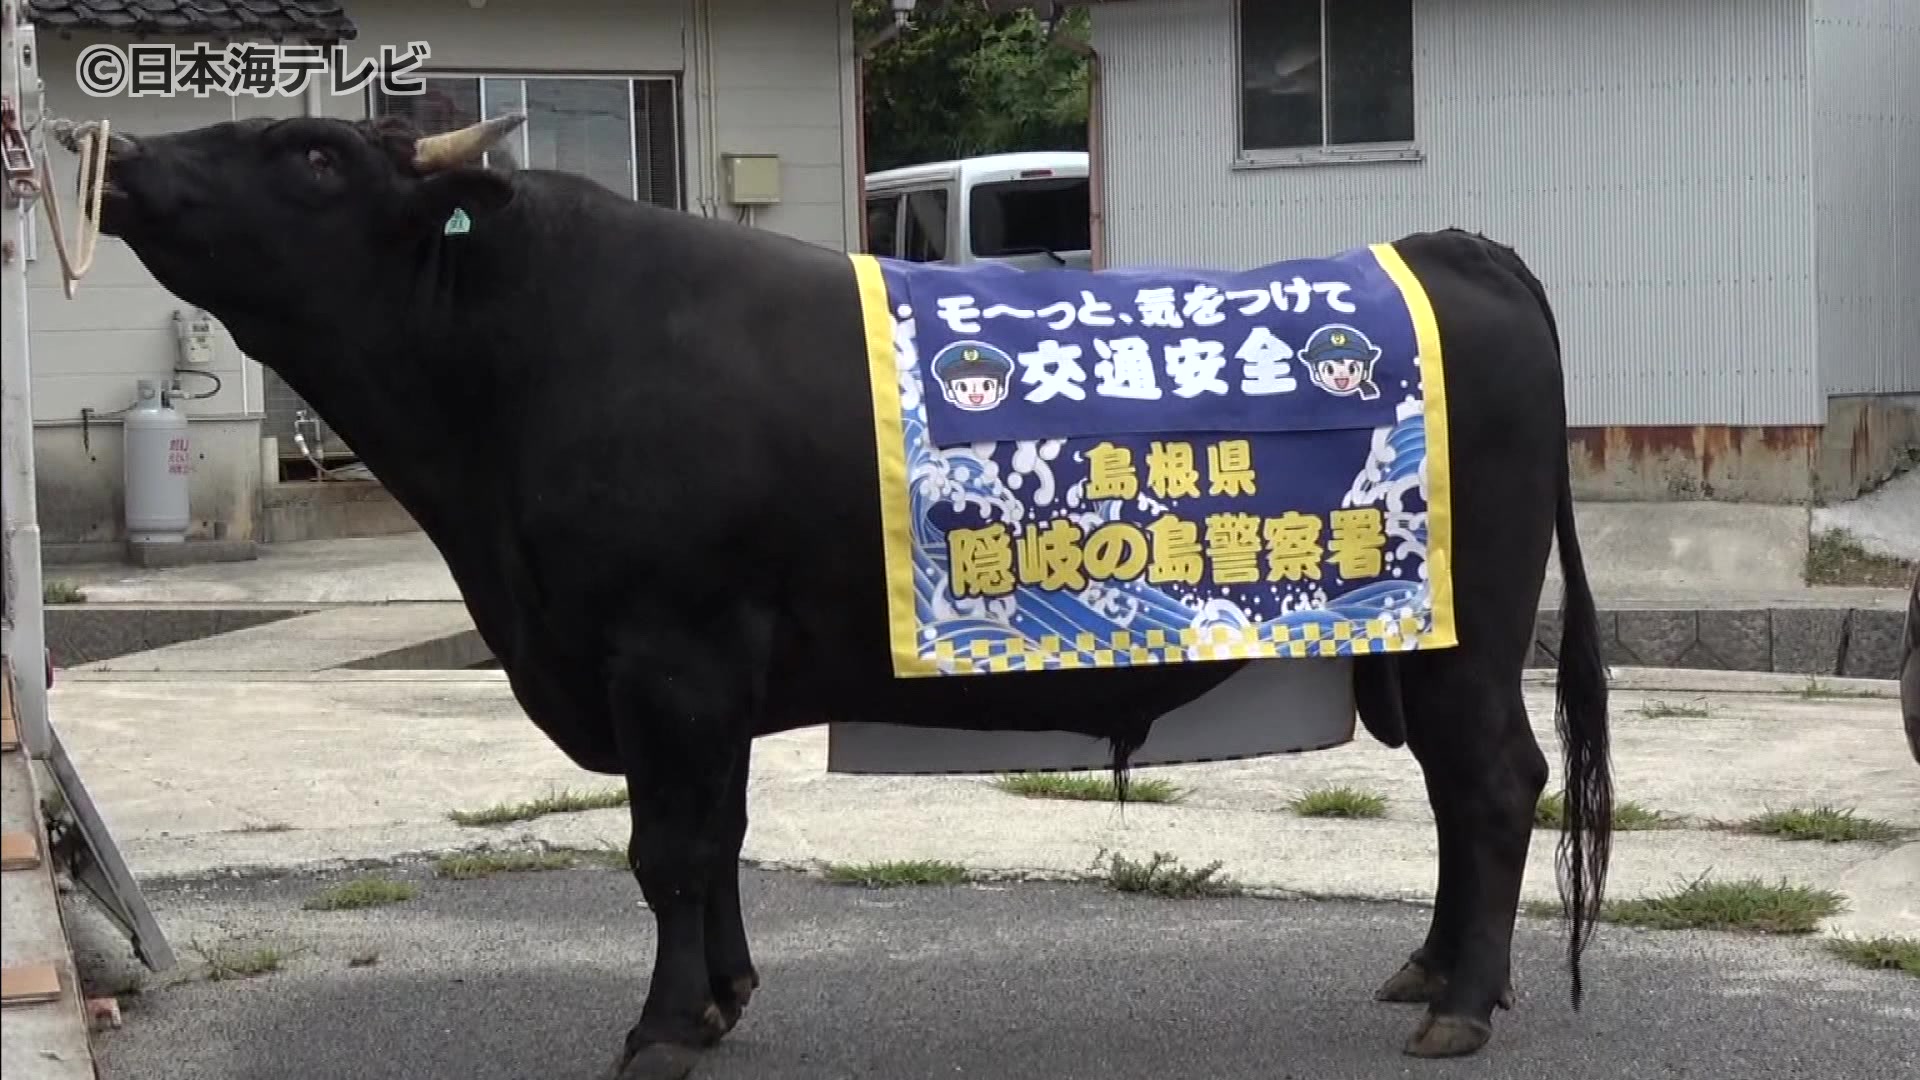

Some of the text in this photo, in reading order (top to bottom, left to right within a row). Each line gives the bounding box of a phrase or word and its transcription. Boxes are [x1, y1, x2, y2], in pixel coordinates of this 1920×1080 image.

[1021, 327, 1297, 403] 交通安全
[1086, 439, 1257, 500] 島根県
[947, 509, 1387, 599] 隠岐の島警察署
